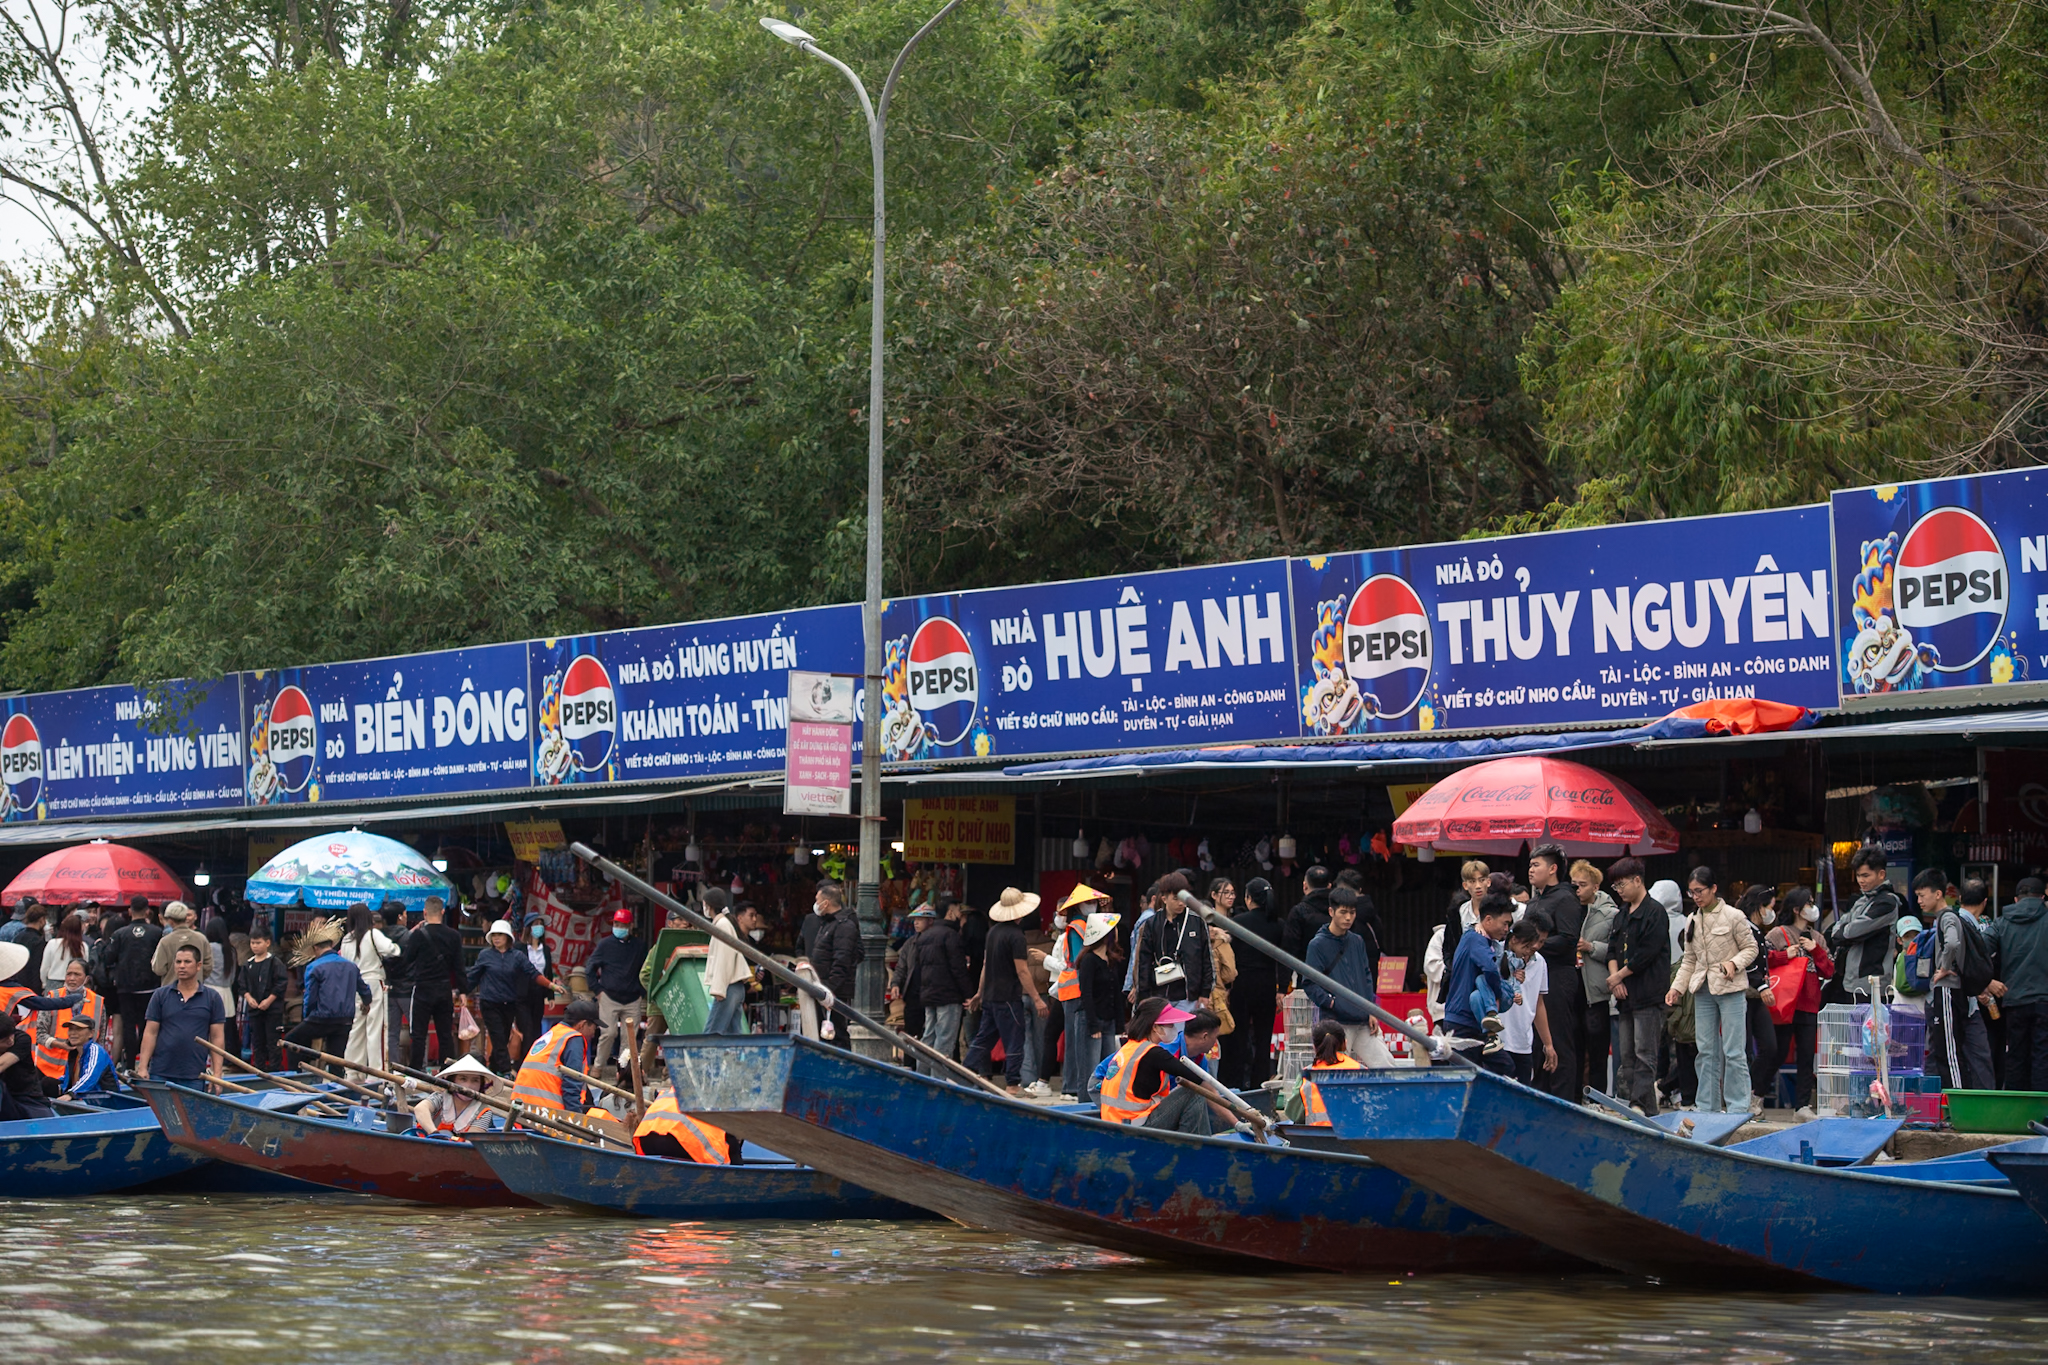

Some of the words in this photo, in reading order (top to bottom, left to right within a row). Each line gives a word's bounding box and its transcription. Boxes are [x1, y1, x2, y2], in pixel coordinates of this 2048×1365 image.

[1435, 556, 1474, 585] NHÀ
[1477, 553, 1503, 582] ĐÒ
[1899, 568, 2002, 609] PEPSI
[1437, 566, 1580, 665] THỦY
[1592, 554, 1829, 654] NGUYÊN
[990, 608, 1037, 645] NHÀ
[1042, 586, 1152, 693] HUỆ
[1164, 591, 1286, 672] ANH
[618, 656, 649, 685] NHÀ
[652, 654, 675, 682] ĐÒ
[678, 637, 731, 679] HÙNG
[733, 622, 798, 674] HUYỀN
[1348, 630, 1428, 663] PEPSI
[911, 665, 975, 695] PEPSI
[1001, 657, 1034, 692] ĐÒ
[1600, 666, 1621, 684] TÀI
[1633, 664, 1661, 684] LỘC
[1674, 661, 1707, 680] BÌNH
[1711, 662, 1731, 677] AN
[1744, 656, 1785, 675] CÔNG
[1788, 655, 1830, 672] DANH
[1122, 698, 1138, 712] TÀI
[1145, 695, 1166, 712] LỘC
[1174, 694, 1198, 709] BÌNH
[1200, 694, 1216, 707] AN
[1224, 690, 1254, 706] CÔNG
[1256, 689, 1286, 703] DANH
[1442, 688, 1473, 709] VIẾT
[1474, 688, 1493, 707] SỚ
[1496, 686, 1526, 706] CHỮ
[1528, 688, 1558, 704] NHO
[1562, 679, 1596, 701] CẦU:
[1601, 689, 1648, 707] DUYÊN
[1660, 685, 1679, 707] TỰ
[115, 695, 141, 721] NHÀ
[320, 697, 348, 723] NHÀ
[355, 671, 425, 755] BIỂN
[432, 677, 527, 748] ĐÔNG
[562, 700, 613, 726] PEPSI
[621, 699, 685, 742] KHÁNH
[687, 693, 739, 736] TOÁN
[996, 714, 1021, 731] VIẾT
[1022, 712, 1038, 729] SỚ
[1039, 711, 1063, 727] CHỮ
[1065, 713, 1090, 726] NHO
[1091, 706, 1118, 724] CẦU:
[1123, 715, 1157, 731] DUYÊN
[1165, 714, 1179, 731] TỰ
[1188, 711, 1209, 727] GIẢI
[1211, 712, 1233, 729] HẠN
[147, 734, 197, 774] HƯNG
[199, 723, 242, 769] VIÊN
[270, 727, 315, 752] PEPSI
[325, 733, 345, 759] ĐÒ
[3, 752, 41, 774] PEPSI
[46, 737, 84, 781] LIÊM
[85, 733, 134, 784] THIỆN
[624, 752, 642, 769] VIẾT
[654, 751, 671, 767] CHỮ
[671, 753, 688, 766] NHO
[693, 751, 704, 764] TÀI
[708, 749, 722, 764] LỘC
[726, 748, 742, 762] BÌNH
[743, 750, 752, 761] AN
[757, 746, 776, 760] CÔNG
[325, 771, 337, 783] VIẾT
[345, 770, 356, 782] CHỮ
[357, 771, 368, 782] NHO
[394, 769, 404, 781] LỘC
[408, 766, 420, 778] BÌNH
[421, 767, 429, 777] AN
[433, 765, 448, 776] CÔNG
[449, 765, 465, 774] DANH
[468, 761, 487, 773] DUYÊN
[515, 759, 527, 770] HẠN
[116, 795, 130, 805] DANH
[167, 790, 177, 804] LỘC
[193, 788, 206, 800] BÌNH
[206, 789, 215, 799] AN
[231, 787, 242, 798] CON
[980, 799, 998, 812] ANH
[1462, 784, 1540, 803] Coca-Cola
[1548, 786, 1615, 806] Coca-Cola
[909, 813, 934, 841] VIẾT
[937, 816, 955, 842] SỚ
[957, 818, 983, 843] CHỮ
[986, 822, 1011, 845] NHO
[1550, 819, 1582, 834] Coca-Cola
[55, 867, 109, 880] Coca-Cola
[118, 867, 161, 880] Coca-Cola
